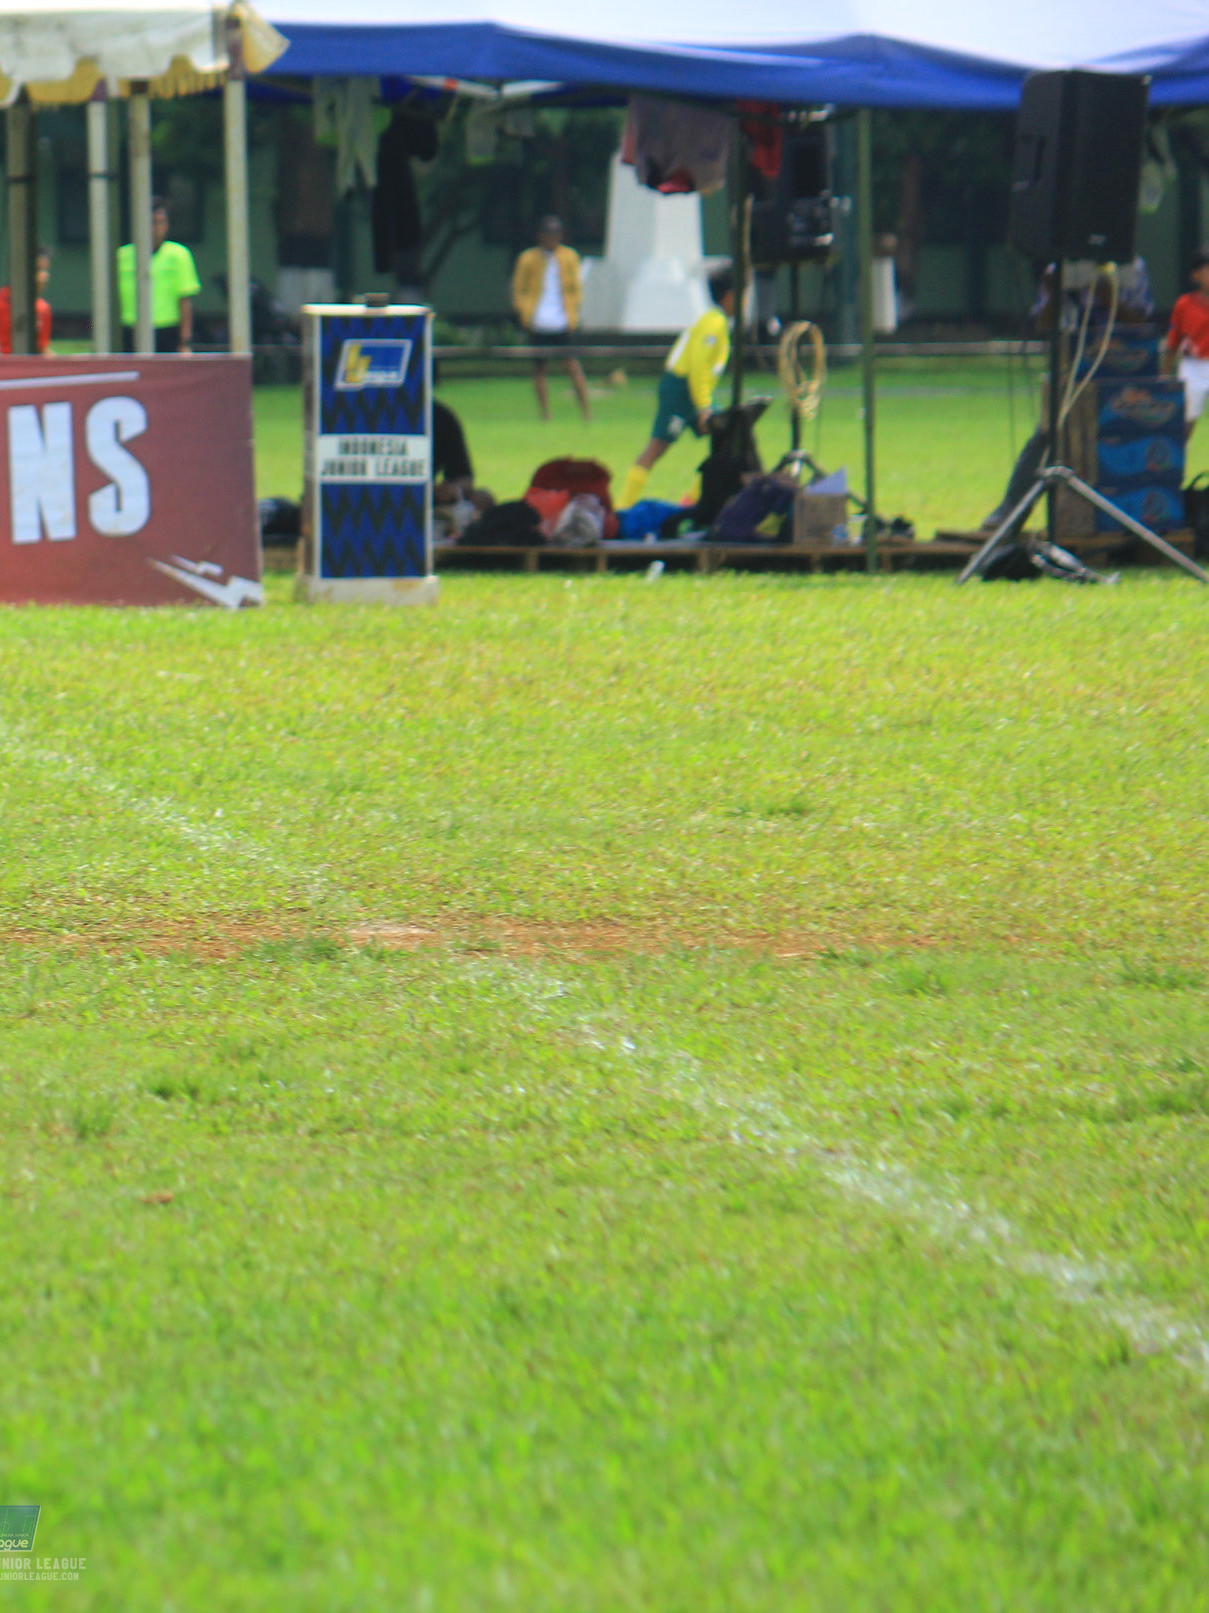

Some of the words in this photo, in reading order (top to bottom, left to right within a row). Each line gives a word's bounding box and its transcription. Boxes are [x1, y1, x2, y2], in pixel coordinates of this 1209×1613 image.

[339, 437, 408, 456] INDONESIA
[321, 458, 367, 477] JUNIOR
[375, 458, 425, 477] LEAGUE
